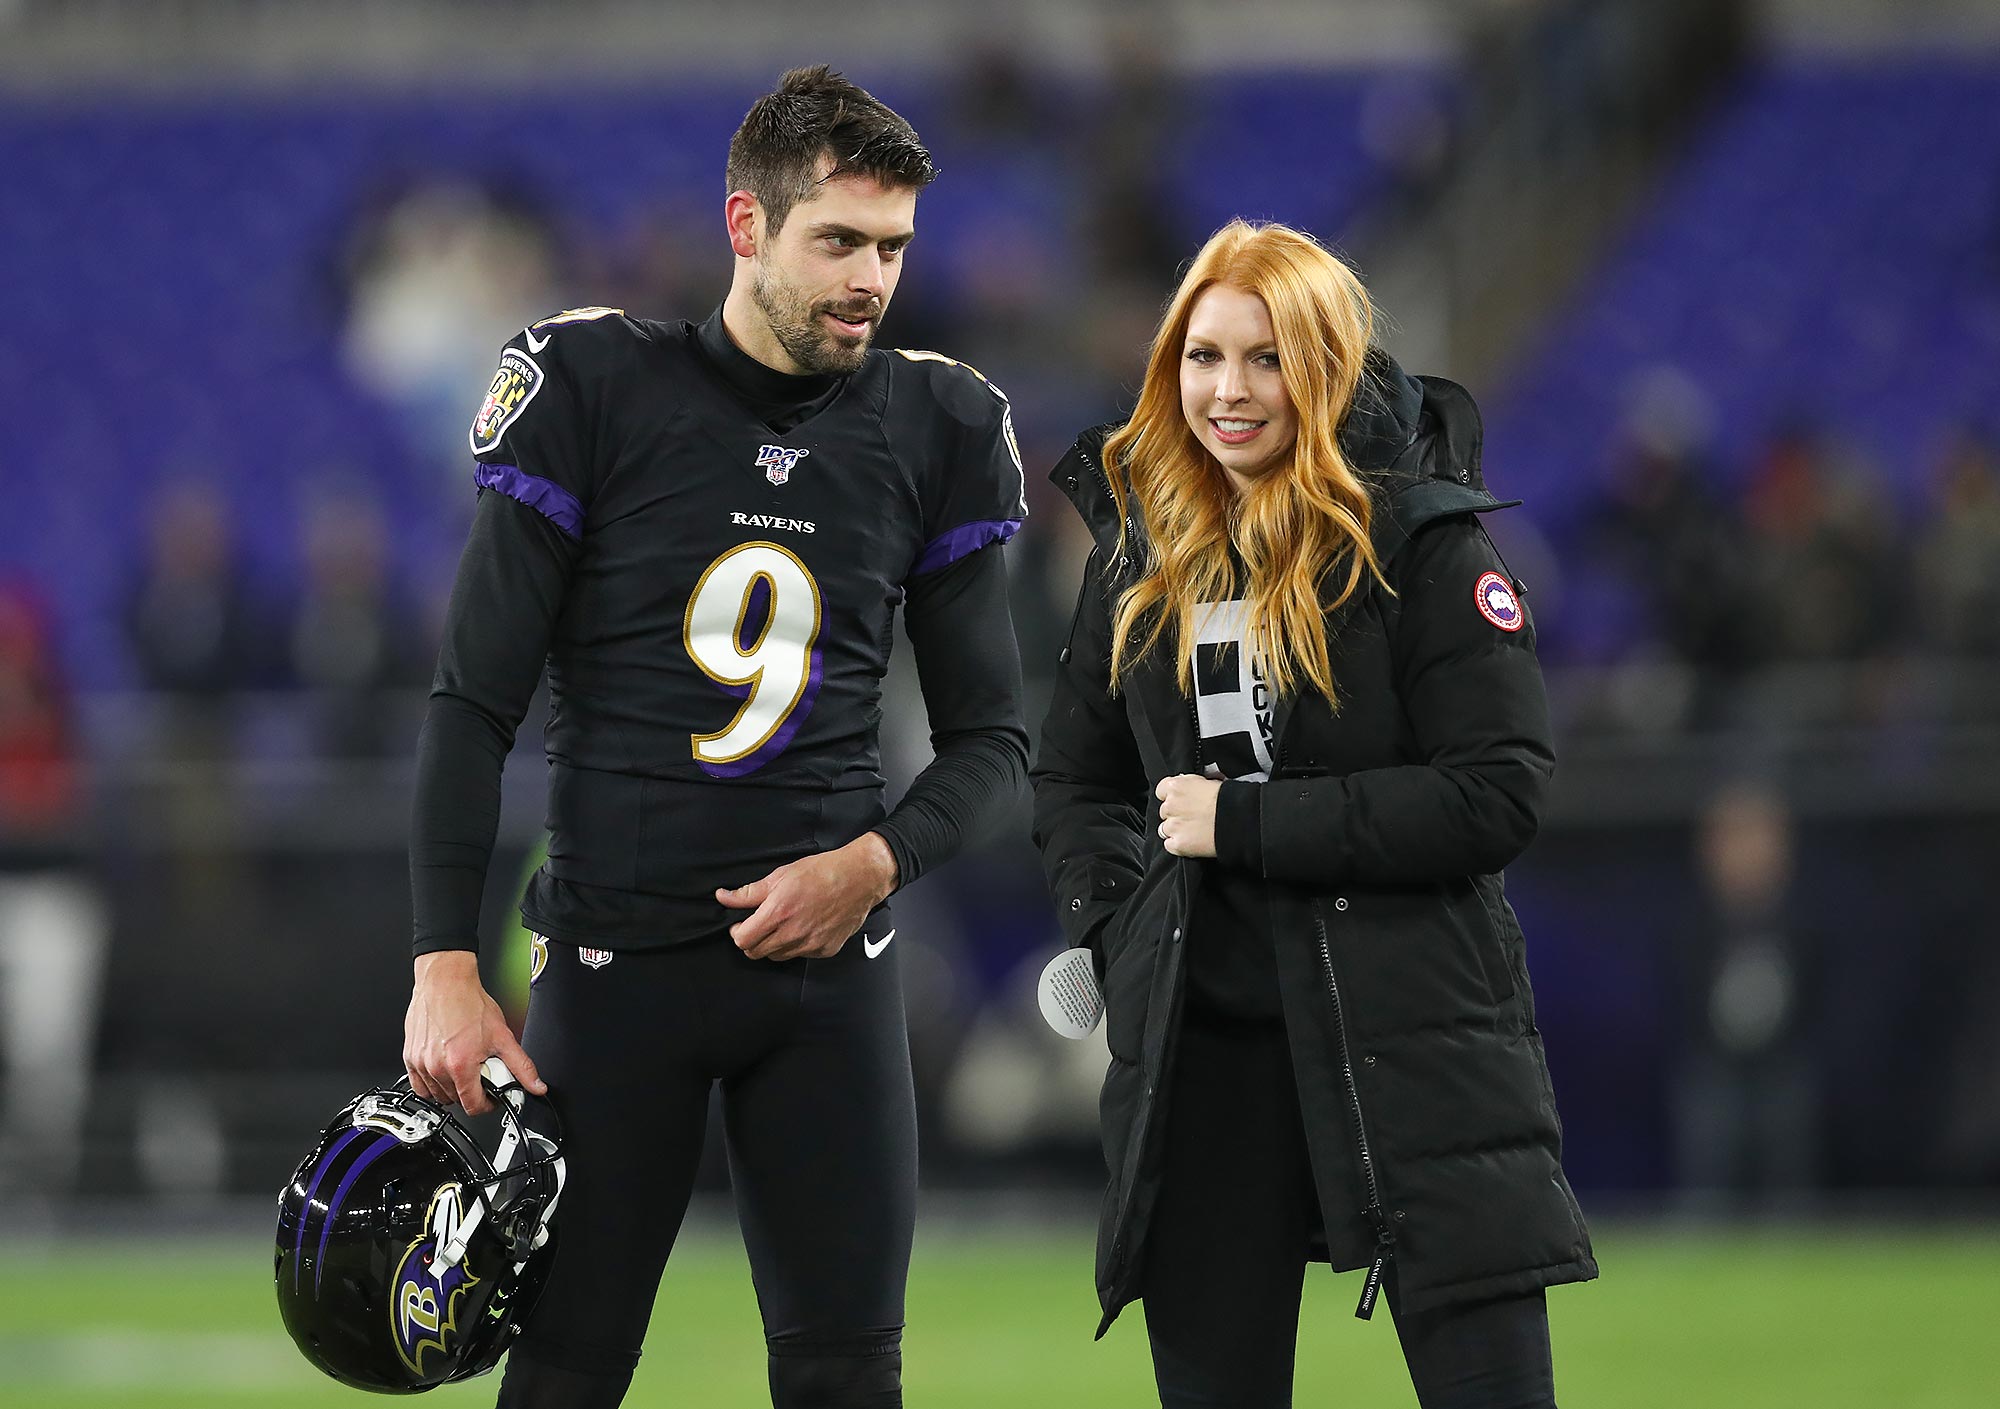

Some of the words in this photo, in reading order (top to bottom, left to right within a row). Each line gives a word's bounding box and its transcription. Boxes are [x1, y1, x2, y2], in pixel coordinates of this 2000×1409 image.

[729, 511, 817, 534] RAVENS
[682, 540, 830, 778] 9
[1369, 1258, 1382, 1285] CANADA
[1362, 1286, 1373, 1311] GOOSE
[400, 1280, 440, 1345] B
